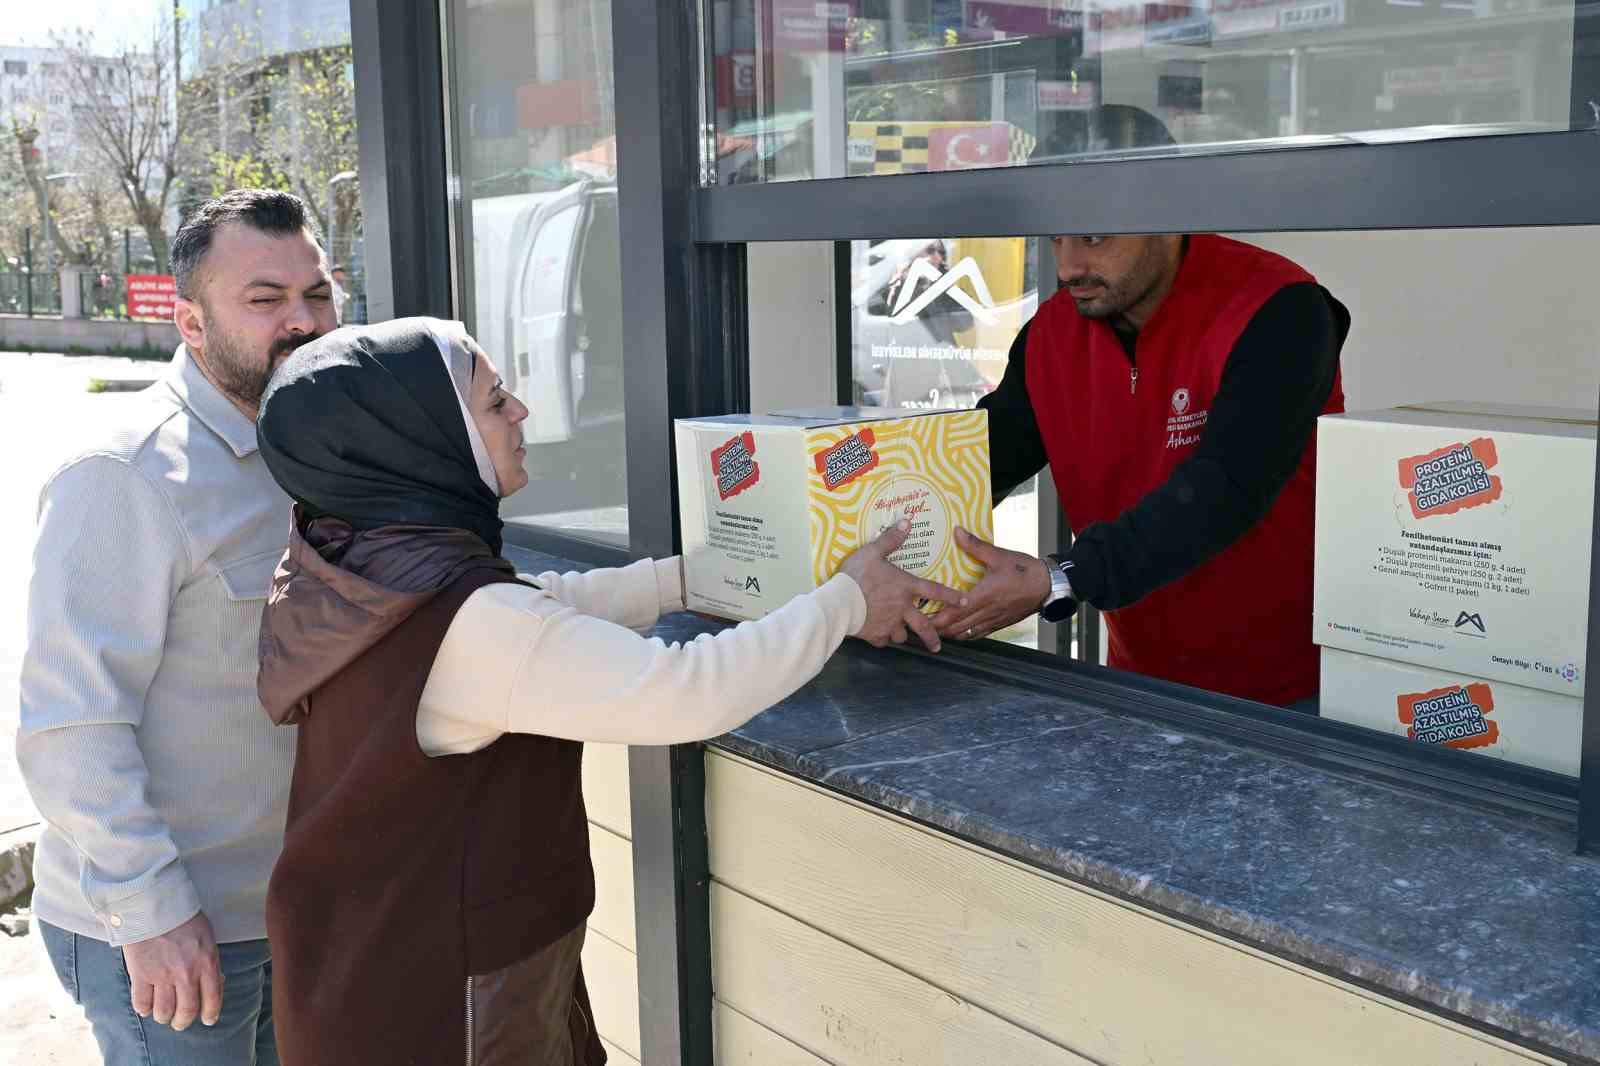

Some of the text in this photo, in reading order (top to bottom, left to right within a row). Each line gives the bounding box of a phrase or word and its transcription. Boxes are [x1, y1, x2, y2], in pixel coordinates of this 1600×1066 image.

[1416, 447, 1472, 478] PROTEİNİ
[1415, 462, 1485, 495] AZALTILMIŞ
[1419, 474, 1490, 509] GIDA KOLİSİ
[1415, 690, 1469, 715] PROTEİNİ
[1414, 706, 1481, 730] AZALTILMIŞ
[1447, 719, 1487, 738] KOLİSİ
